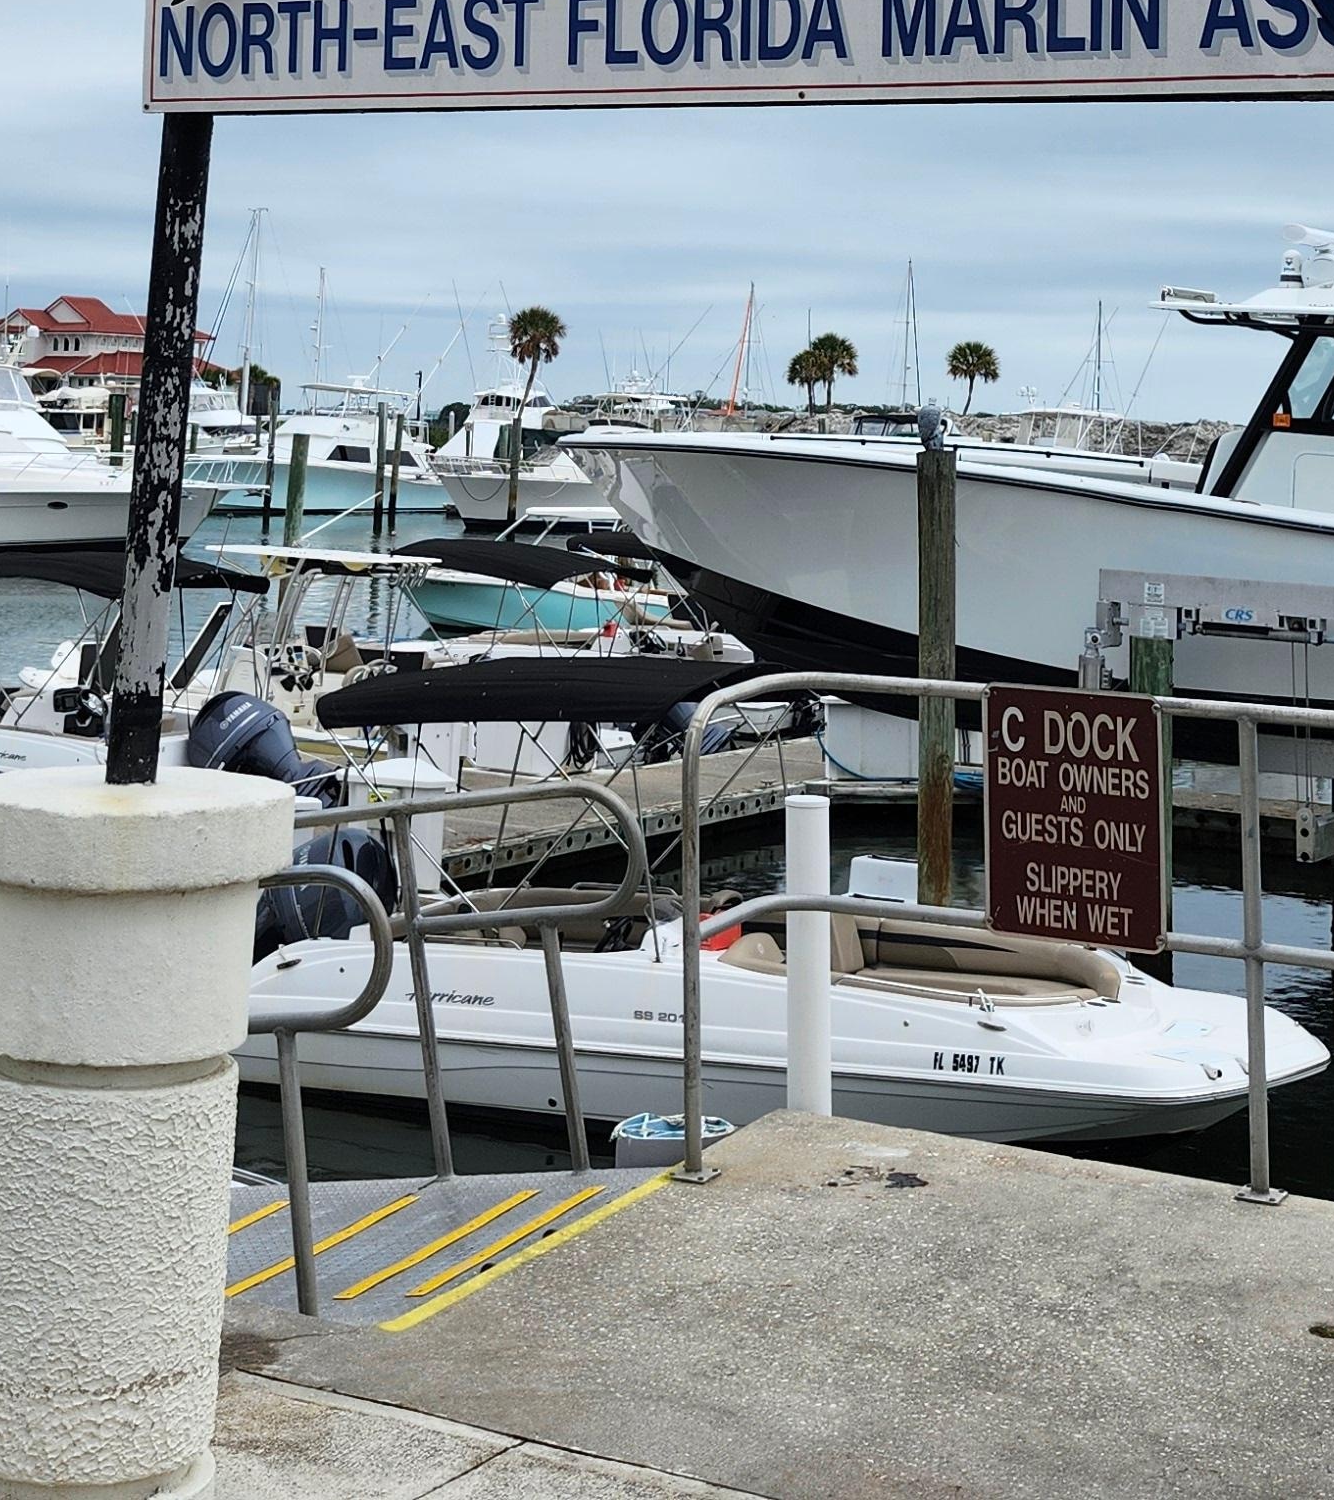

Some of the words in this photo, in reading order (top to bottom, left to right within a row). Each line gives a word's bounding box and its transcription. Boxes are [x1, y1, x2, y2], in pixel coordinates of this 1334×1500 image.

[1224, 608, 1254, 622] CRS
[227, 701, 254, 724] YAMAHA
[1001, 706, 1026, 752] C
[1043, 709, 1140, 763] DOCK
[997, 756, 1049, 789] BOAT
[1058, 762, 1150, 800] OWNERS
[1060, 794, 1087, 814] AND
[1001, 810, 1084, 847] GUESTS
[1093, 819, 1147, 853] ONLY
[1026, 861, 1122, 901] SLIPPERY
[1016, 894, 1077, 931] WHEN
[1087, 903, 1134, 938] WET
[405, 989, 496, 1007] rricane
[633, 1010, 654, 1020] SS
[932, 1051, 945, 1071] FL
[951, 1052, 981, 1074] 5497
[988, 1056, 1006, 1076] TK
